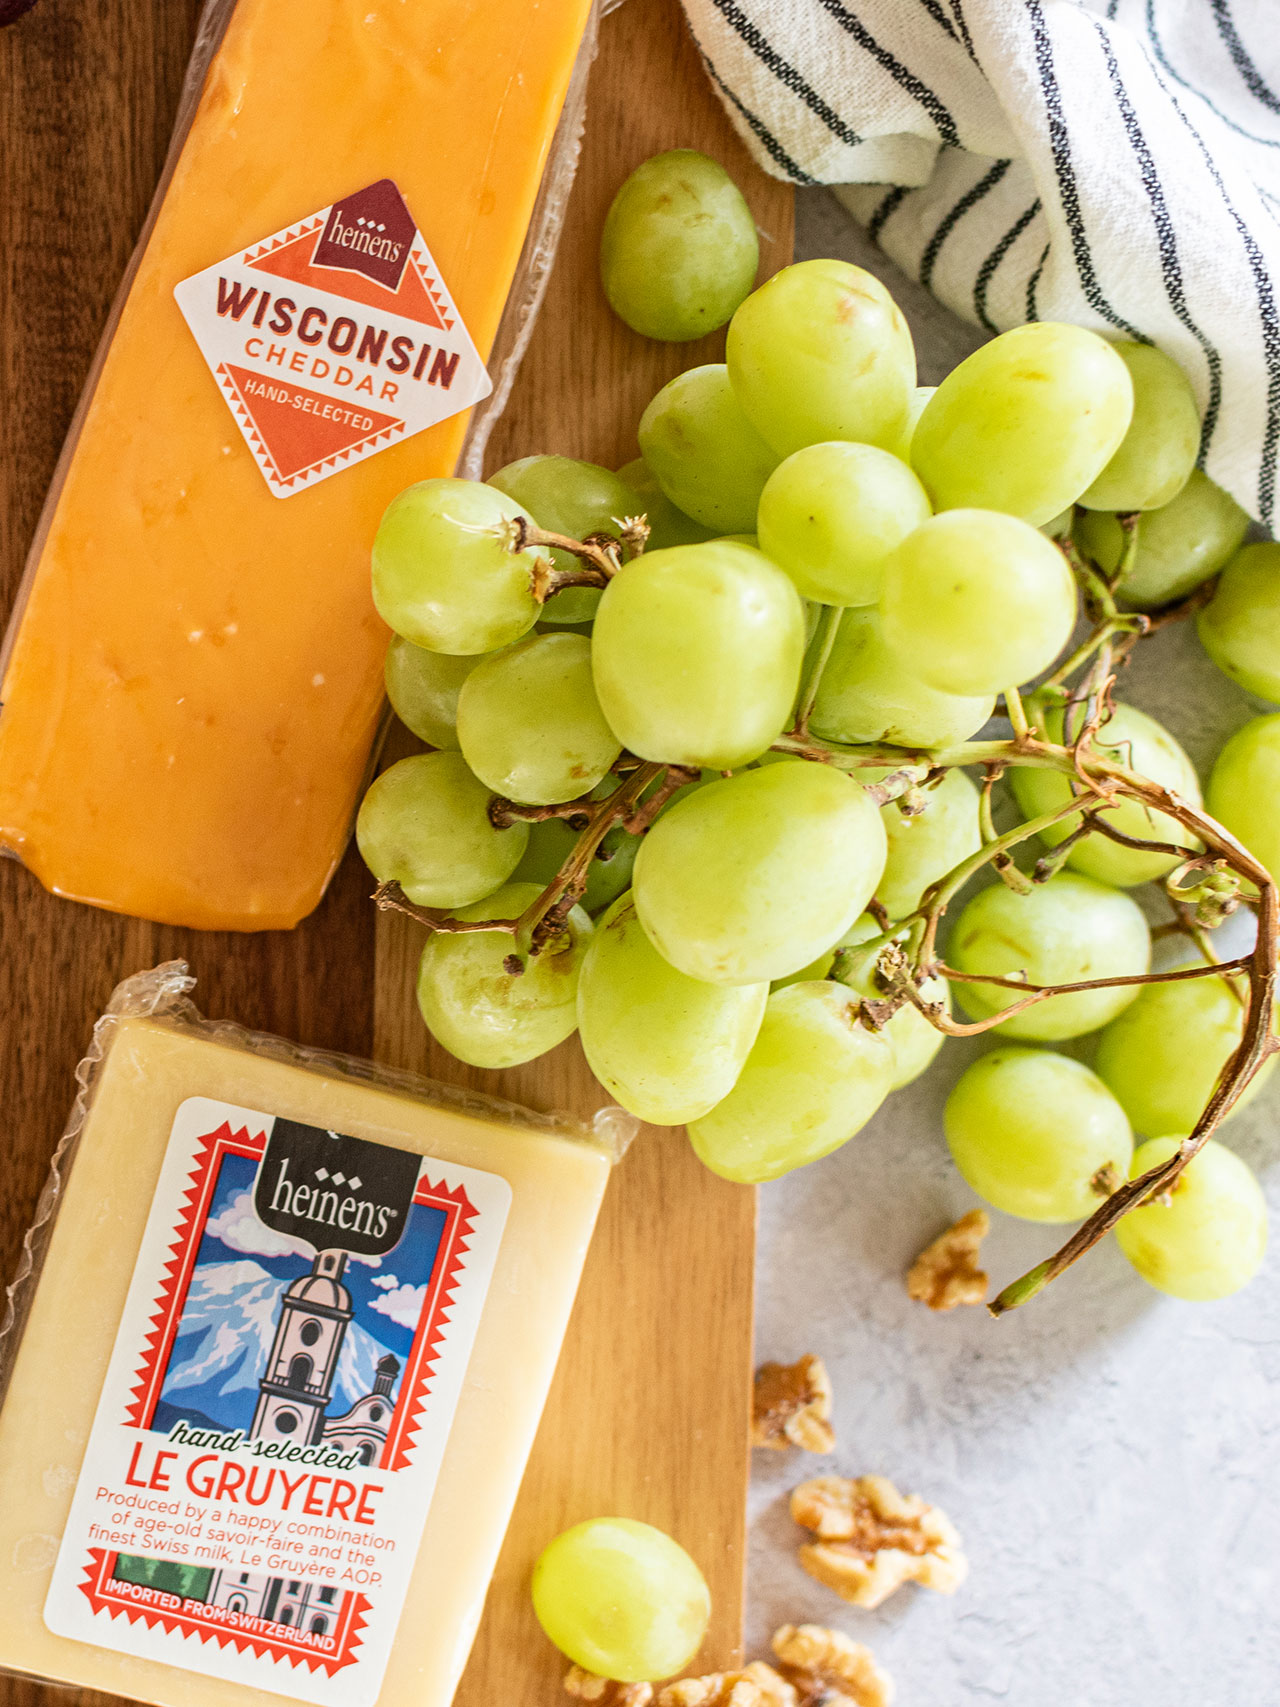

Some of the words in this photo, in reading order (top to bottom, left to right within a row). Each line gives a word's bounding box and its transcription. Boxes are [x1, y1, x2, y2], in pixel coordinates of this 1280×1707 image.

[217, 276, 460, 391] WISCONSIN
[245, 337, 400, 403] CHEDDAR
[244, 379, 373, 431] HAND-SELECTED
[169, 1423, 359, 1471] hand-selected
[125, 1441, 178, 1491] LE
[185, 1454, 384, 1525] GRUYERE
[96, 1487, 180, 1515] Produced
[185, 1502, 207, 1521] by
[211, 1510, 221, 1521] a
[227, 1509, 282, 1532] happy
[287, 1522, 395, 1551] combination
[111, 1511, 131, 1525] of
[134, 1516, 202, 1537] age-old
[207, 1528, 303, 1553] savoir-faire
[309, 1544, 342, 1560] and
[348, 1548, 375, 1566] the
[88, 1523, 136, 1546] finest
[141, 1534, 189, 1554] Swiss
[195, 1545, 233, 1563] milk,
[240, 1550, 261, 1566] Le
[267, 1554, 336, 1578] Gruyère
[340, 1567, 382, 1587] AOP.
[105, 1578, 181, 1609] IMPORTED
[182, 1598, 231, 1622] FROM
[229, 1609, 336, 1651] SWITZERLAND
